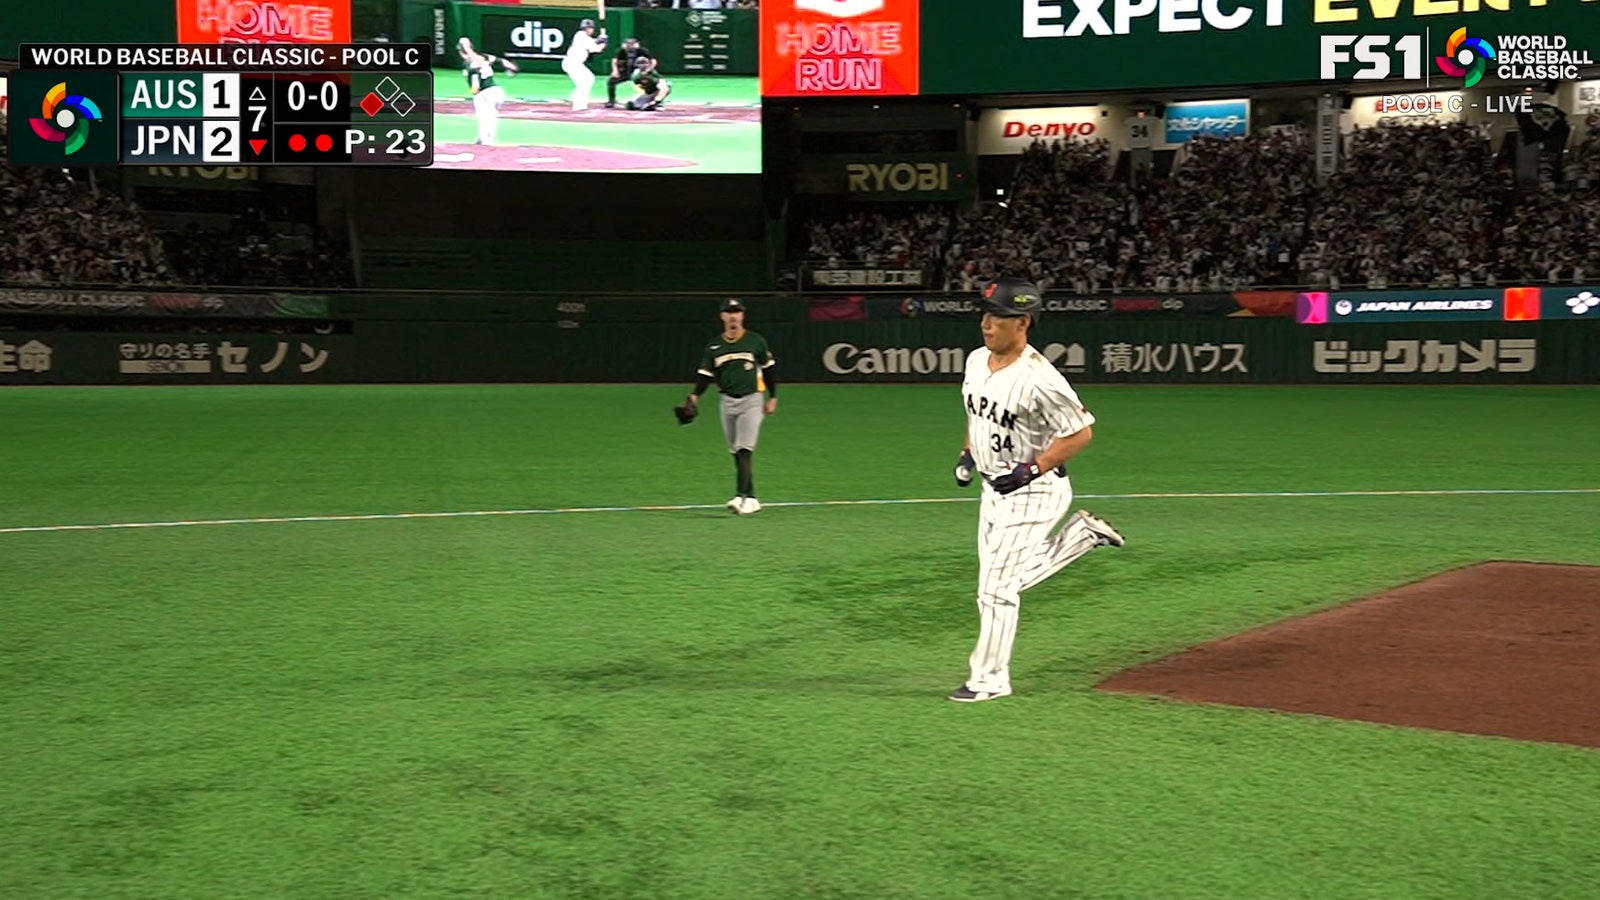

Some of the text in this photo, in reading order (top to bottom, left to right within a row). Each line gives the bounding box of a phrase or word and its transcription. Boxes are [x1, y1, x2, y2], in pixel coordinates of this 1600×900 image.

[510, 20, 564, 53] dip
[775, 22, 902, 56] HOME
[795, 57, 882, 91] RUN
[1003, 121, 1096, 138] Denyo
[846, 162, 949, 192] RYOBI
[1047, 300, 1108, 311] CLASSIC
[1356, 300, 1493, 312] JAPAN AIRLINES
[119, 342, 211, 359] 守りの名手
[216, 340, 329, 374] セノン
[822, 343, 964, 374] Canon
[1102, 343, 1249, 374] 積水ハウス
[1313, 339, 1537, 373] ビックカメラ
[966, 393, 1018, 431] APAN
[991, 433, 1015, 453] 34
